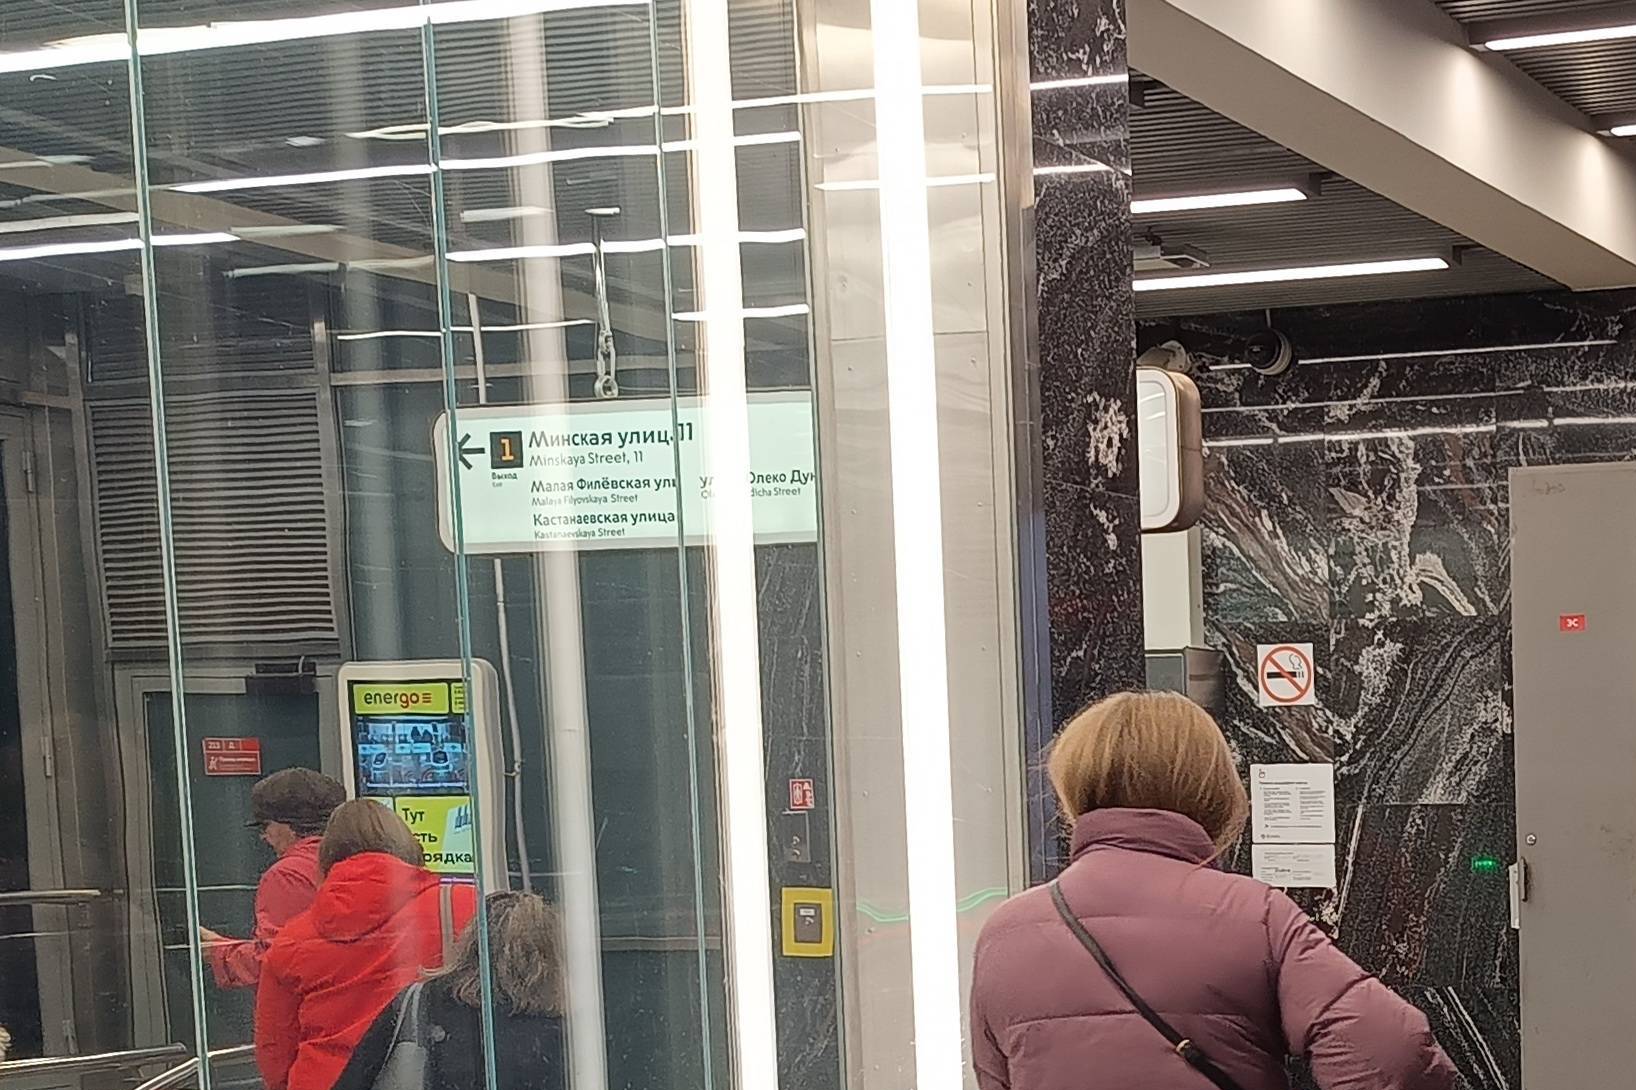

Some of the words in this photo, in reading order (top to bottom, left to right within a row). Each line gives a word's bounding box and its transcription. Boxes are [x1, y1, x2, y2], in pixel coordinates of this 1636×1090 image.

[528, 430, 613, 448] Минская
[501, 438, 515, 461] 1
[529, 453, 586, 467] Minskaya
[588, 451, 630, 465] Street,
[634, 451, 644, 464] 11
[531, 480, 574, 493] Малая
[576, 476, 651, 491] Филёвская
[774, 486, 801, 497] Street
[610, 494, 638, 504] Street
[533, 512, 628, 526] Кастанаевская
[631, 511, 676, 526] улица
[598, 528, 626, 538] Street
[364, 691, 420, 709] energo
[402, 807, 425, 824] Тут
[413, 833, 438, 843] сть
